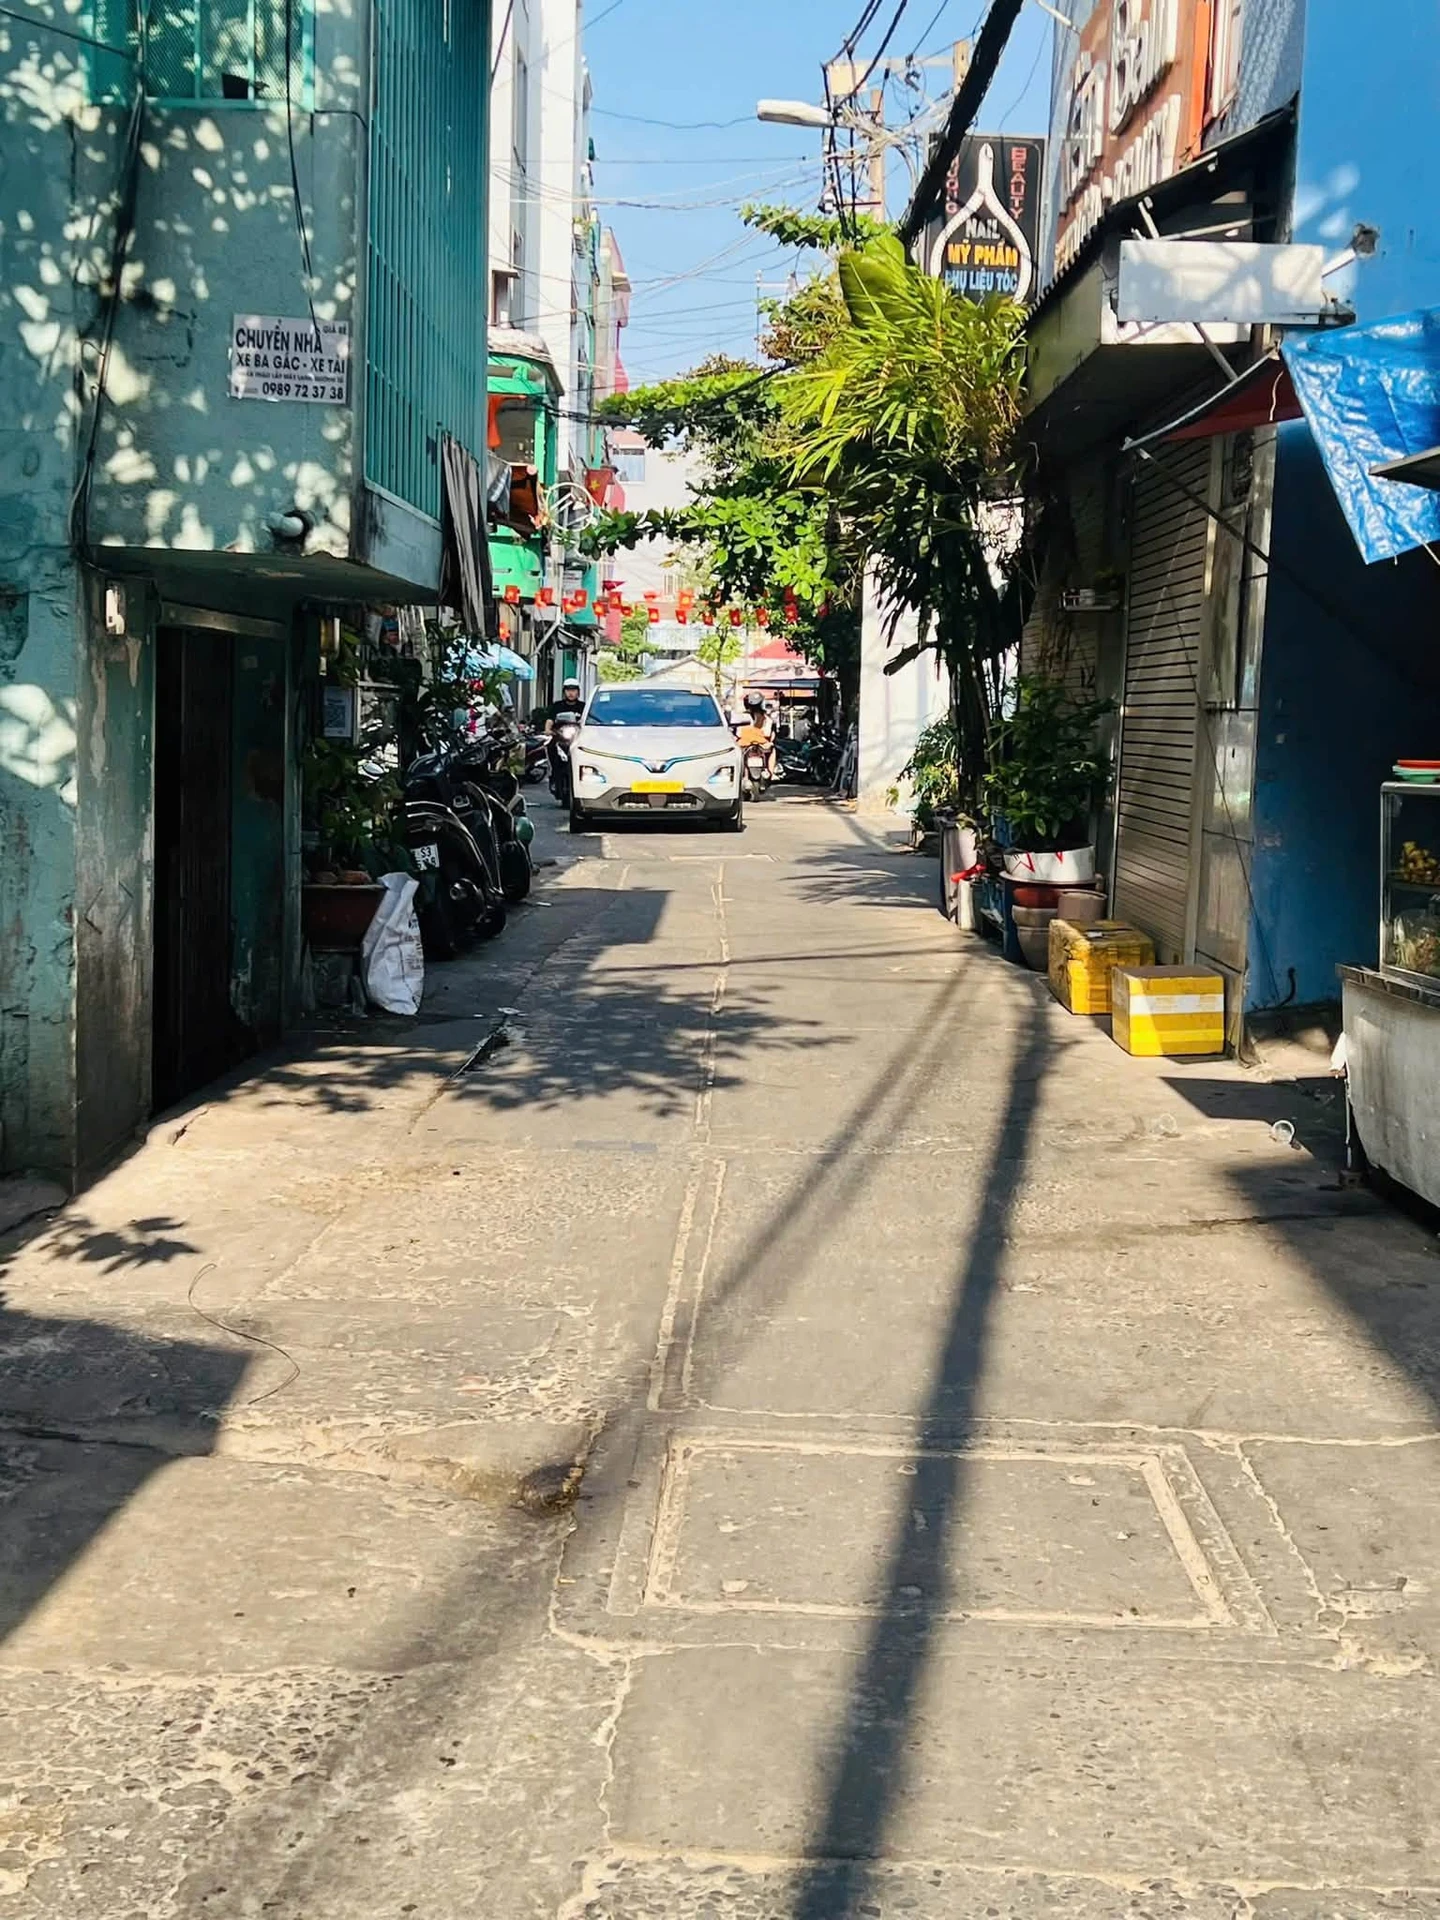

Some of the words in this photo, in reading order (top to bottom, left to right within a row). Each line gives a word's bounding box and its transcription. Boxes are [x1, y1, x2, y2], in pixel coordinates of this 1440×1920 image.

[1010, 147, 1026, 219] BEAUTY
[965, 218, 1001, 240] NAIL
[947, 238, 972, 265] MỸ
[974, 237, 1019, 268] PHẨM
[996, 267, 1018, 293] TÓC
[235, 318, 291, 352] CHUYỂN
[294, 327, 323, 354] NHÀ
[236, 352, 251, 367] XE
[254, 354, 269, 369] BA
[273, 351, 300, 370] GÁC
[310, 357, 325, 372] XE
[327, 354, 345, 374] TẢI
[262, 382, 291, 397] 0989
[294, 383, 309, 398] 72
[312, 385, 326, 399] 37
[329, 386, 344, 400] 38
